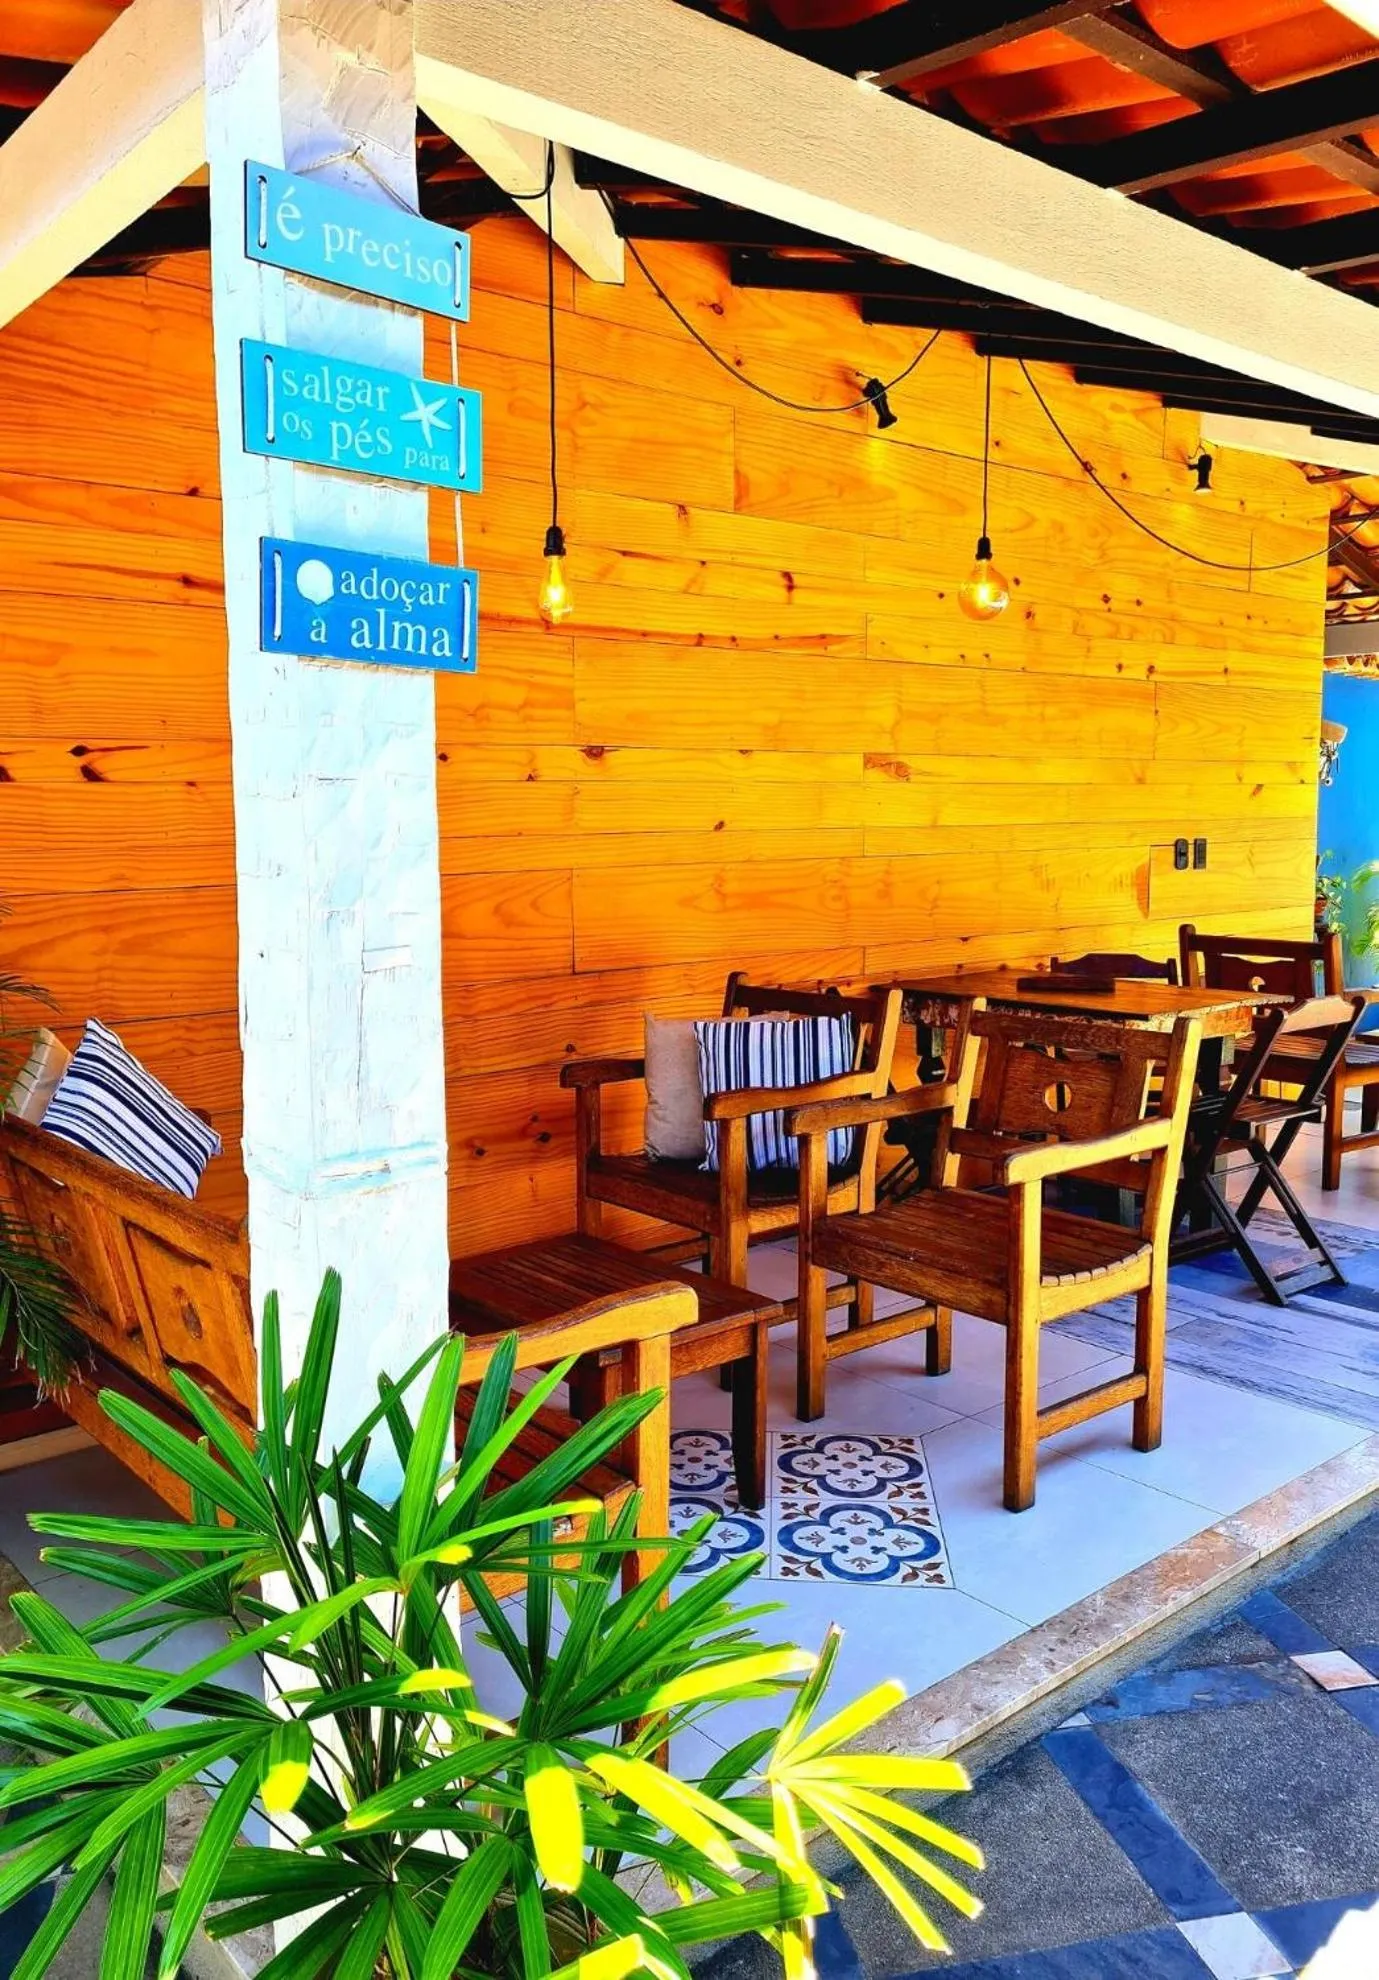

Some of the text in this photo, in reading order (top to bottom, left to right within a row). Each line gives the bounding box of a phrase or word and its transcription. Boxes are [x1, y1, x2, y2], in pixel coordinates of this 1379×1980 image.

[276, 186, 451, 287] é preciso
[281, 366, 391, 413] salgar
[282, 411, 450, 471] os pés para
[340, 567, 450, 612] adoçar
[310, 608, 453, 657] a alma
